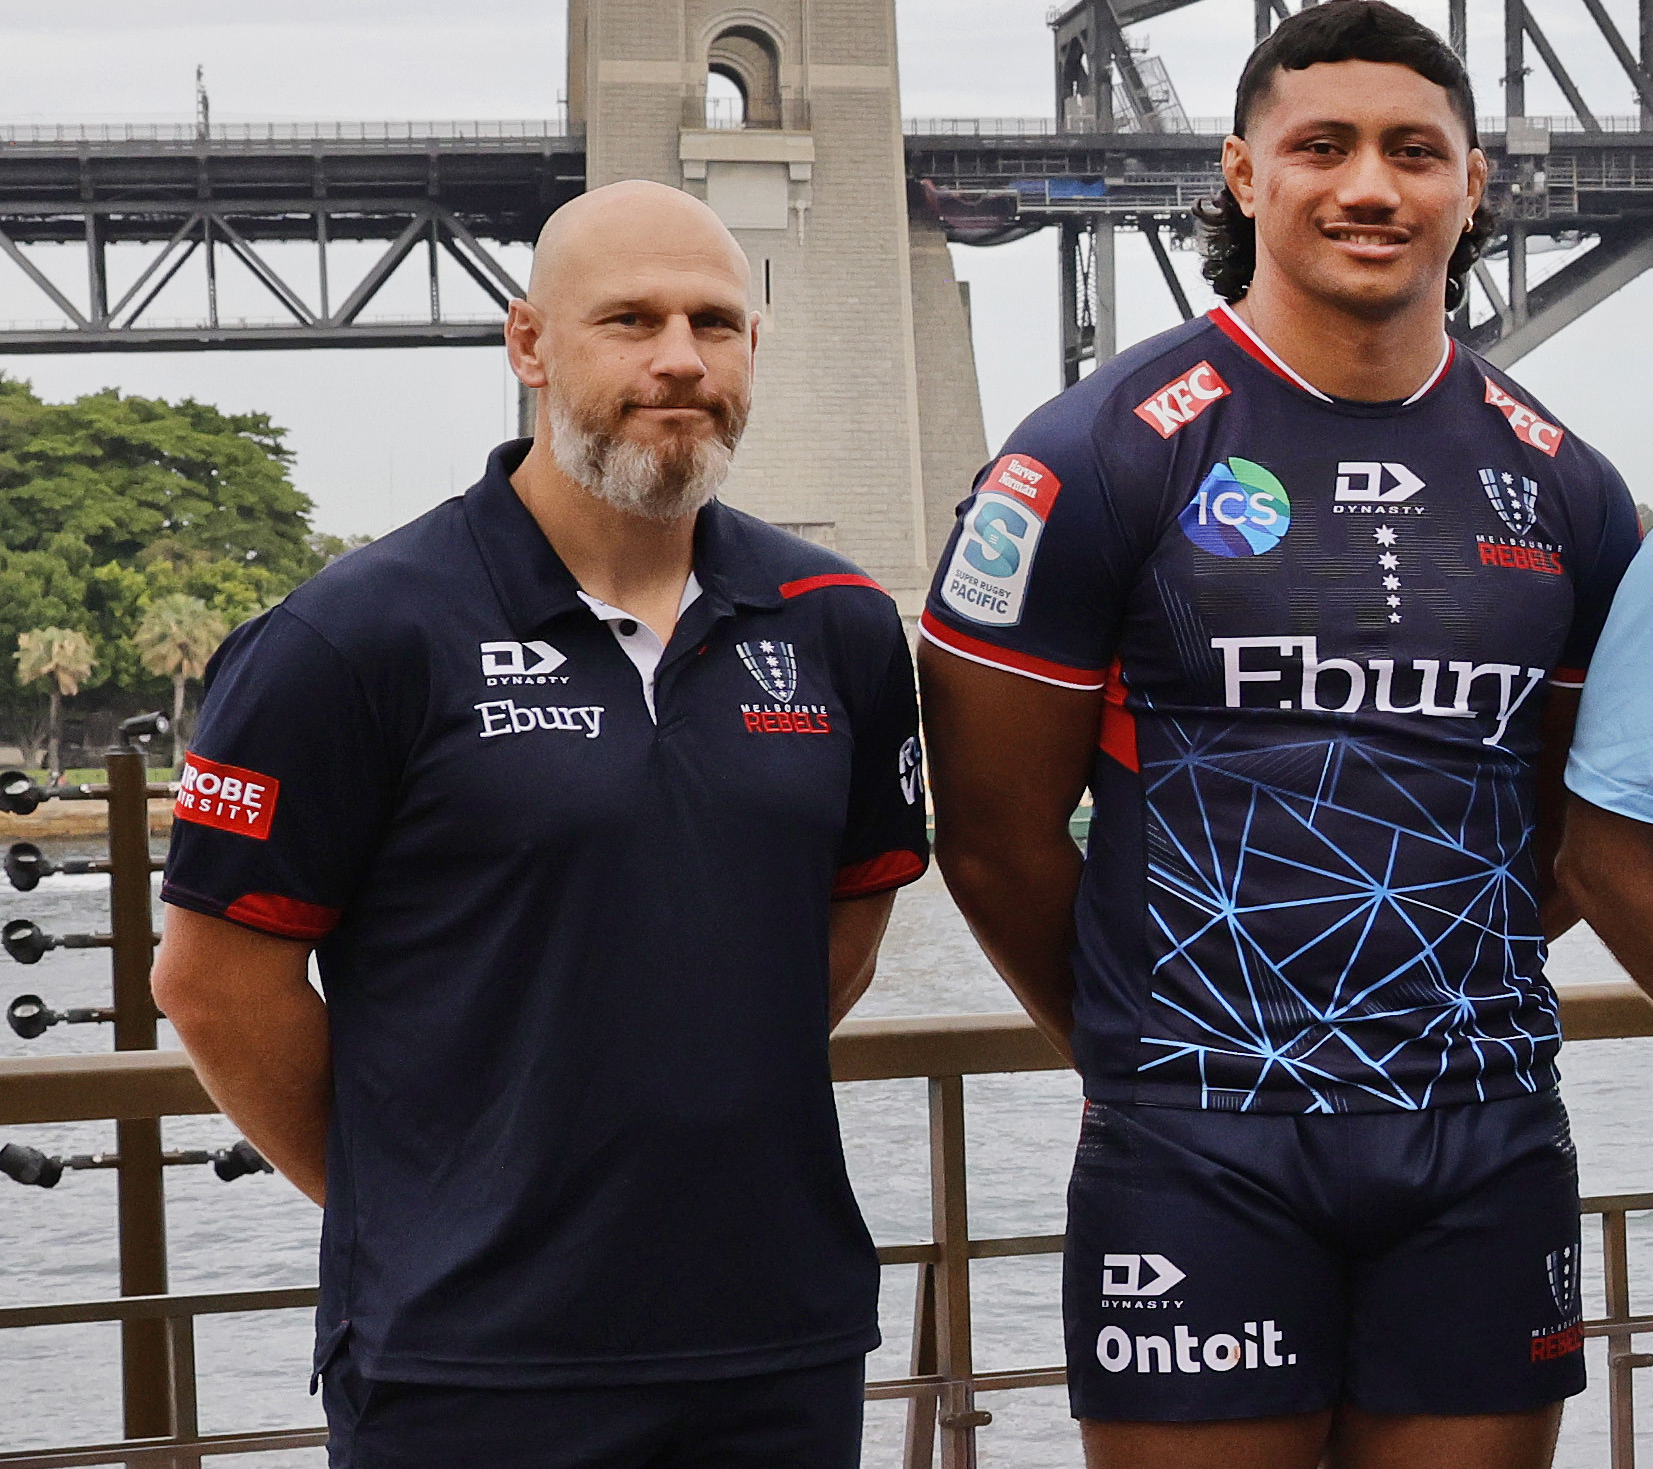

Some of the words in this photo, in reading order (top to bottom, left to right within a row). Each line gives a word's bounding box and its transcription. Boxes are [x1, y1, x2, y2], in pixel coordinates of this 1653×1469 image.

[1144, 366, 1223, 434] KFC
[1197, 491, 1279, 526] ICS
[1333, 505, 1426, 515] DYNASTY
[1475, 534, 1564, 551] MELBOURNE
[1477, 542, 1564, 576] REBELS
[950, 579, 1010, 615] PACIFIC
[954, 569, 979, 586] SUPER
[980, 581, 1012, 599] RUGBY
[486, 676, 570, 686] DYNASTY
[1210, 636, 1545, 746] Ebury
[474, 699, 605, 739] Ebury
[740, 703, 828, 714] MELBOURNE
[743, 711, 832, 734] REBELS
[181, 762, 266, 809] ROBE
[1101, 1299, 1185, 1310] DYNASTY
[1097, 1320, 1297, 1374] Ontoit.
